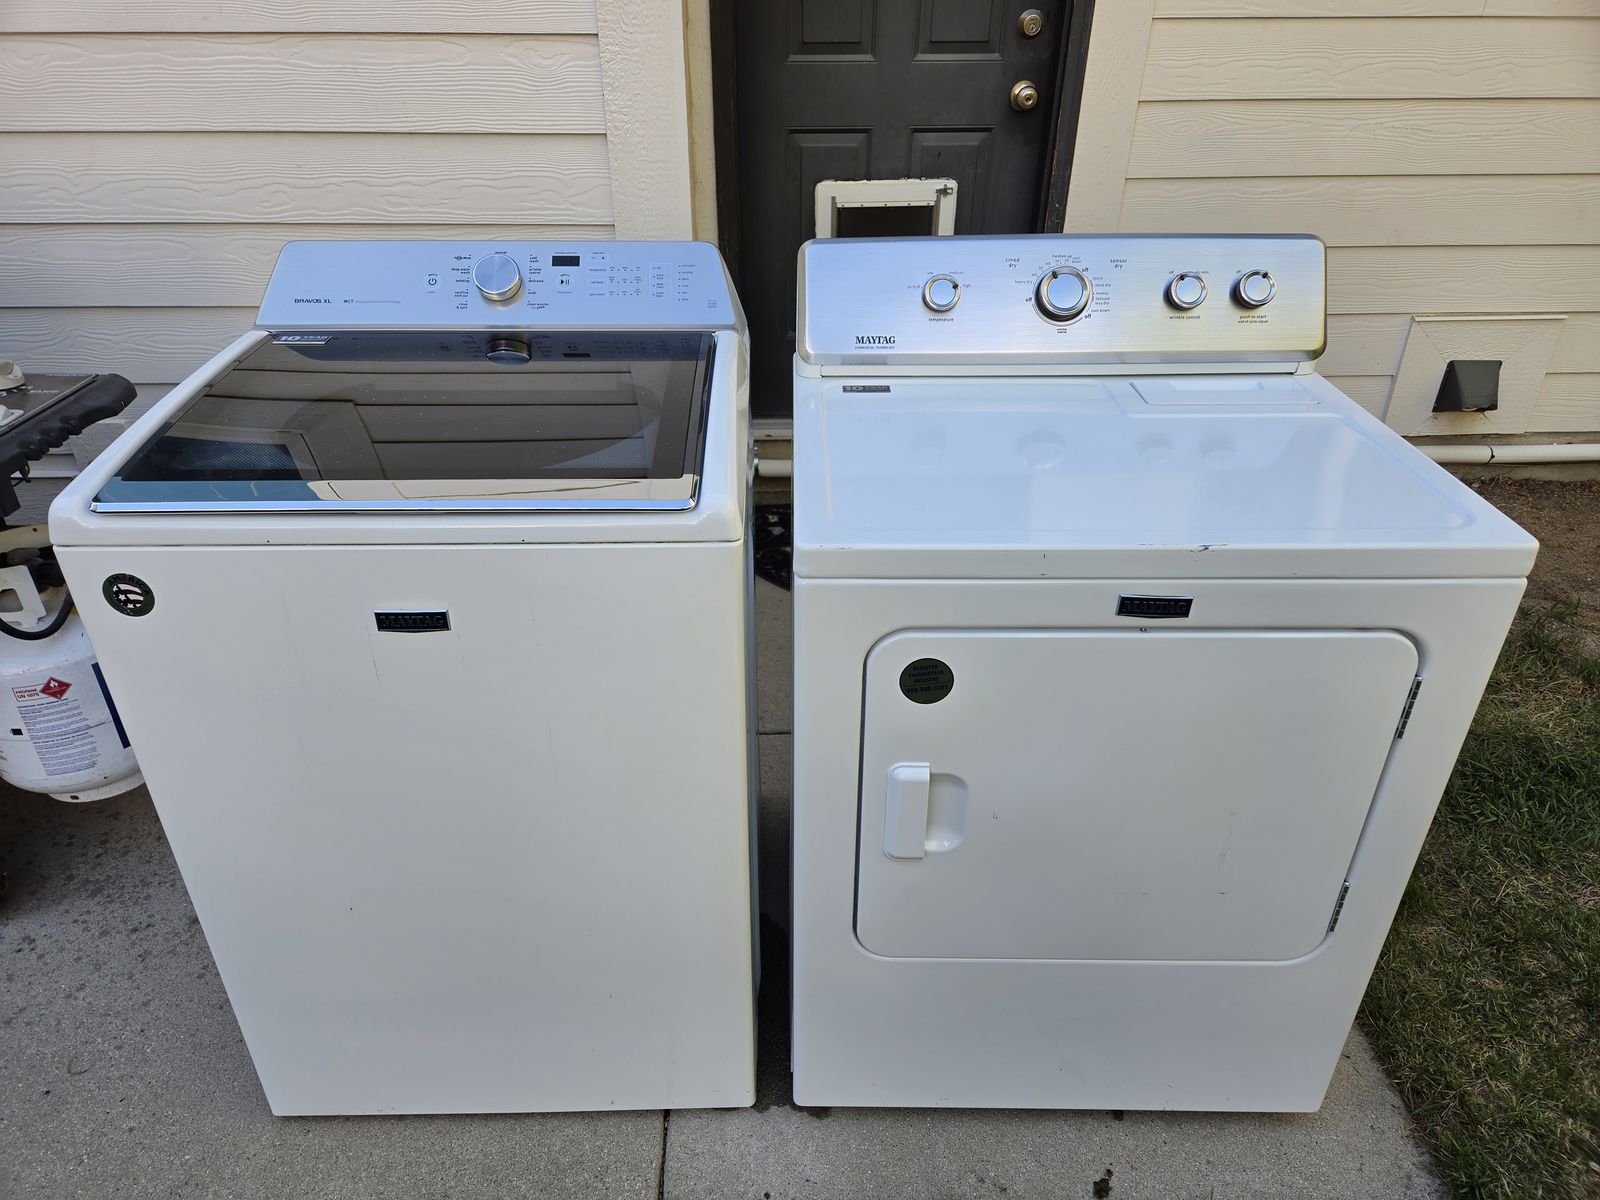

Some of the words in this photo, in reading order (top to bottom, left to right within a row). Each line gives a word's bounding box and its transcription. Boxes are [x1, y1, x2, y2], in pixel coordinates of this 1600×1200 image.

[855, 336, 896, 344] MAYTAG
[1122, 600, 1187, 613] MAYTAG
[379, 616, 444, 627] MAYTAG
